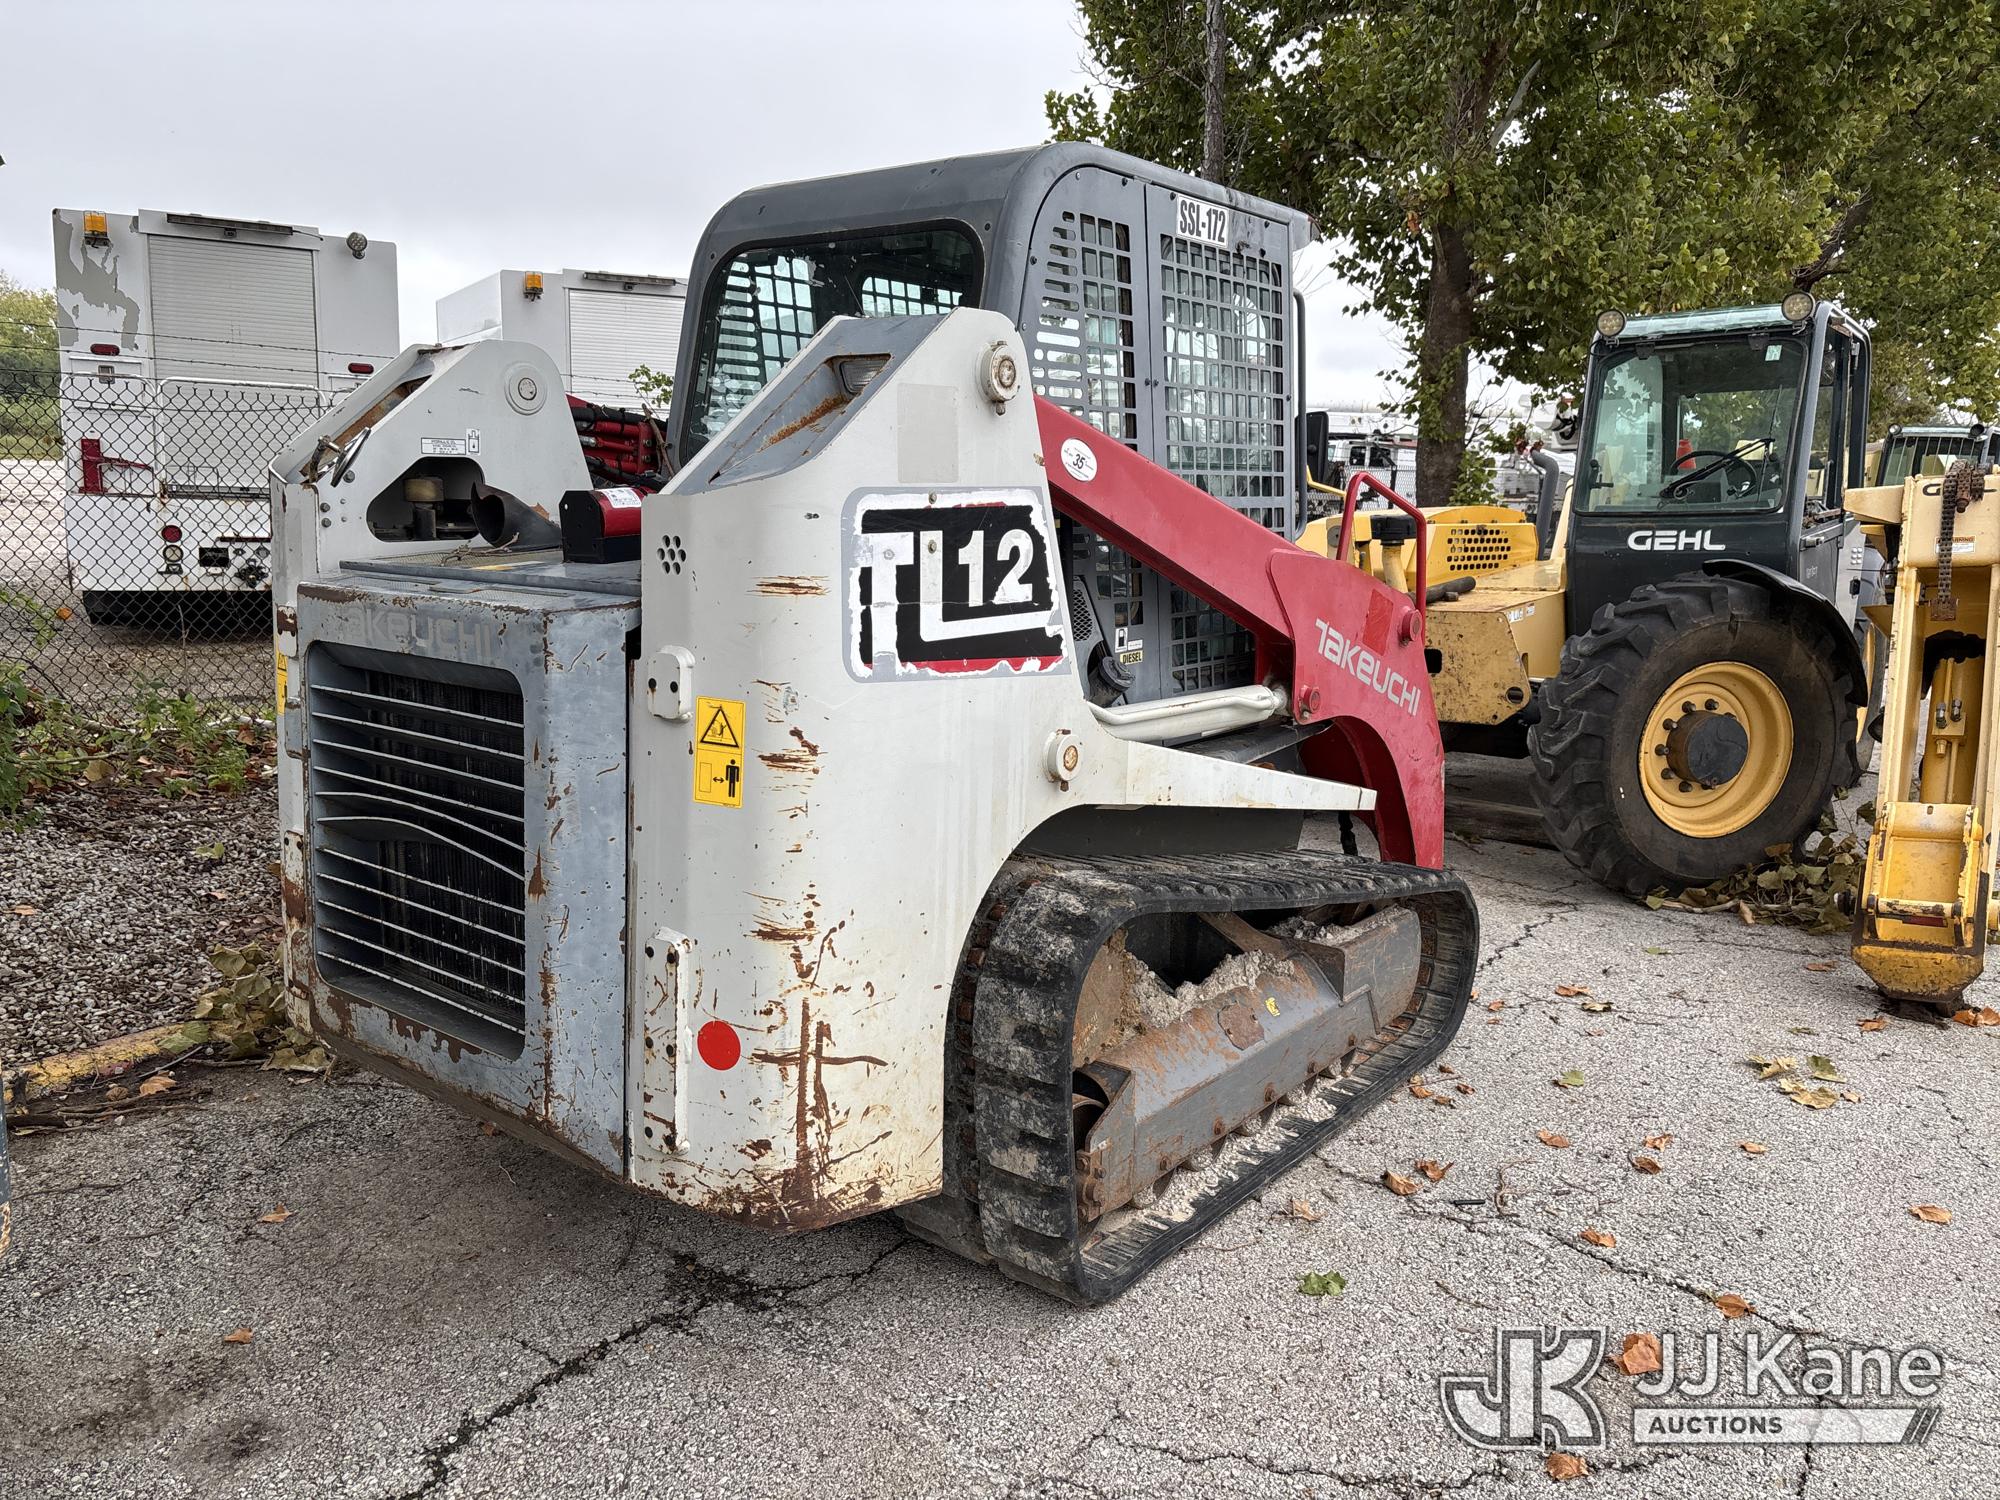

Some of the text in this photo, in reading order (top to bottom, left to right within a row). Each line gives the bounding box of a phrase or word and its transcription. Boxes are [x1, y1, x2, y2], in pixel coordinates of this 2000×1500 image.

[1180, 199, 1226, 243] SSL-172
[1627, 529, 1726, 551] GEHL
[857, 528, 1053, 660] TL12
[1122, 651, 1142, 664] DIESEL
